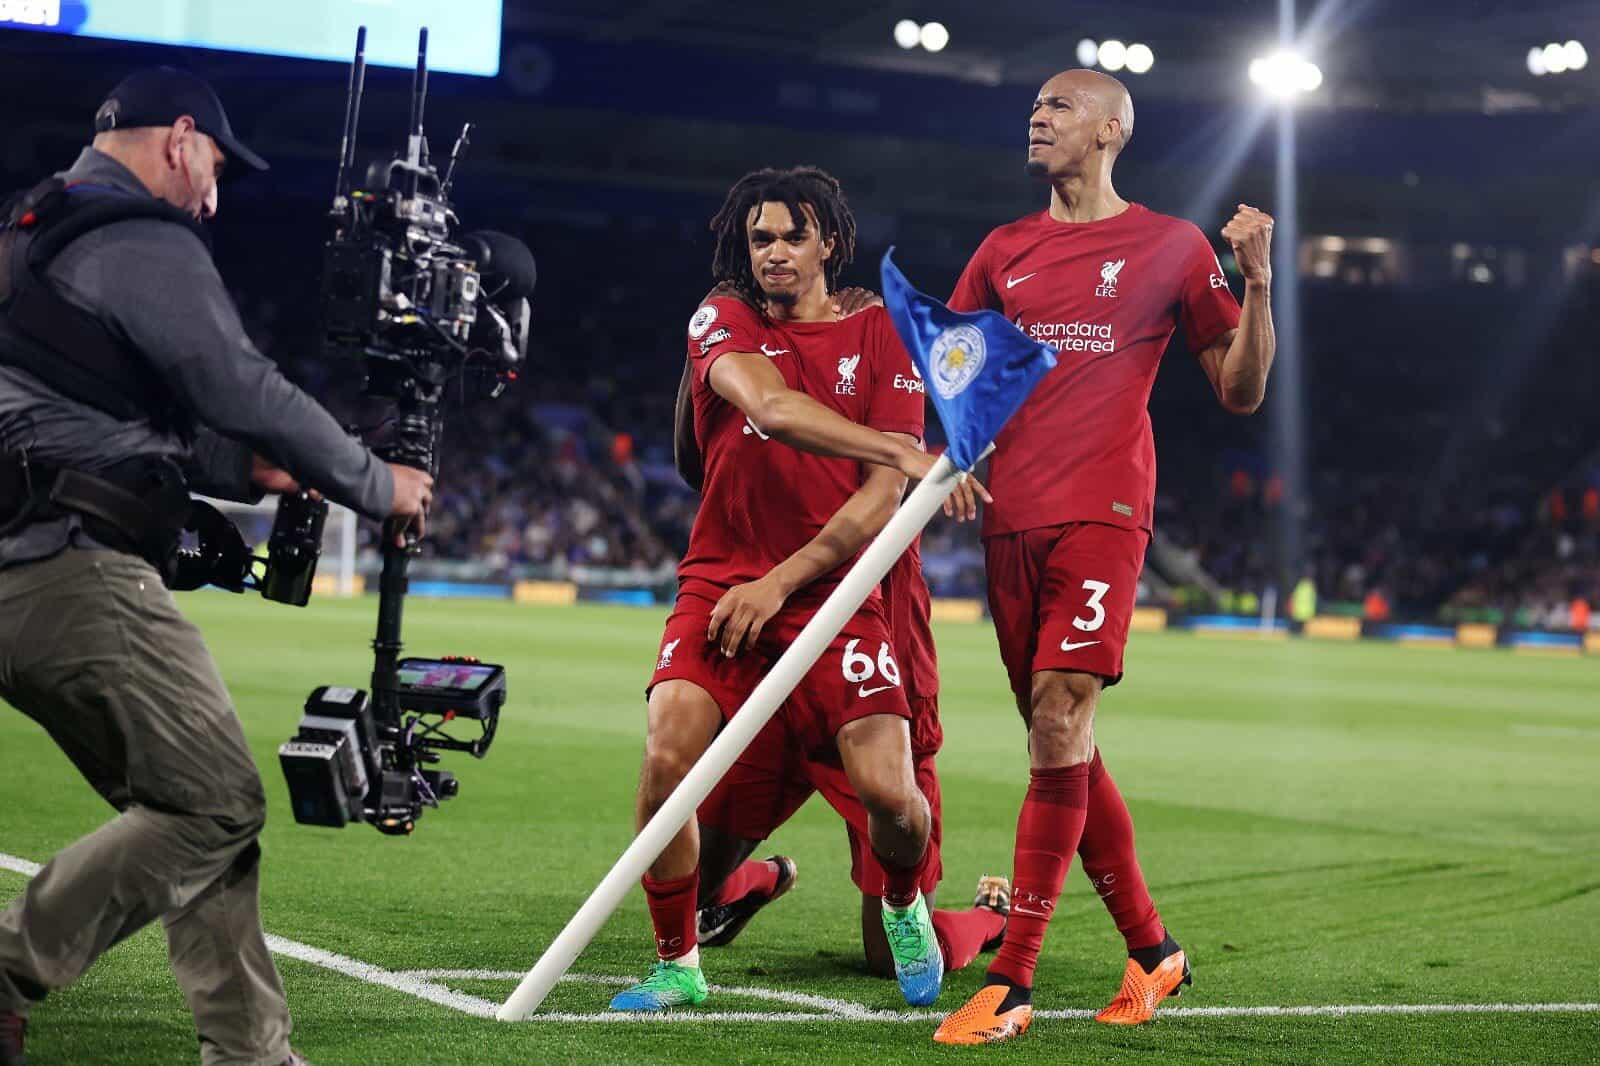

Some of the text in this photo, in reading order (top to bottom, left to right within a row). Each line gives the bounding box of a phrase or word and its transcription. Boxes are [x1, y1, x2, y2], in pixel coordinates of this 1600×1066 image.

[1095, 287, 1118, 298] LFC
[1029, 321, 1112, 339] standard
[1033, 336, 1115, 353] hartered
[835, 384, 857, 396] LFC
[1072, 579, 1111, 632] 3
[841, 638, 901, 687] 66
